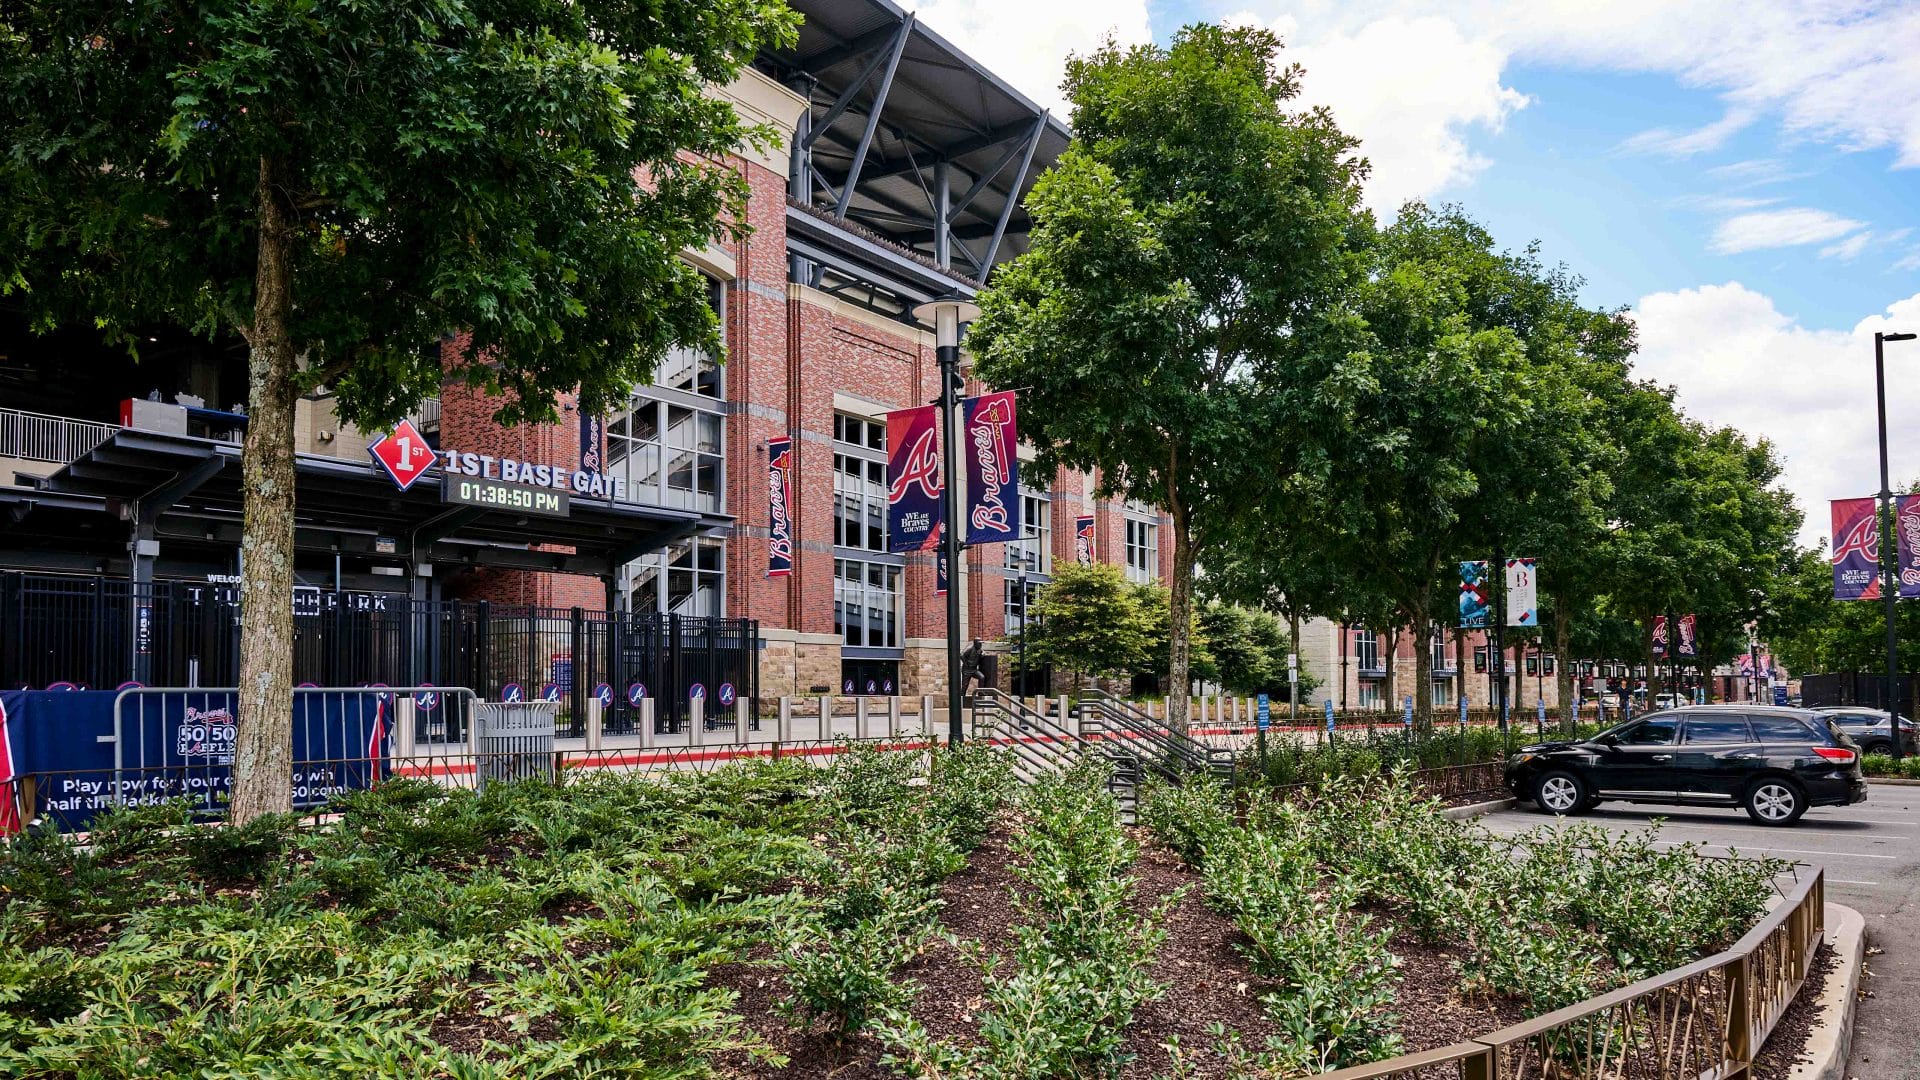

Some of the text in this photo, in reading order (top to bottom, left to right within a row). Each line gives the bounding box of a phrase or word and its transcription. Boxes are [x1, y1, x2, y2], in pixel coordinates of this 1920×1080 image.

[445, 451, 627, 499] 1ST BASE GATE
[889, 428, 940, 504] A
[971, 426, 1011, 533] Braves
[460, 482, 559, 511] 01:38:50 PM
[901, 518, 930, 528] Braves
[905, 512, 920, 520] WE
[1833, 515, 1879, 565] A
[207, 574, 242, 584] WELCO
[1464, 617, 1485, 625] LIVE
[63, 779, 103, 795] Play
[181, 777, 220, 791] your
[309, 768, 334, 782] win
[47, 796, 82, 811] half
